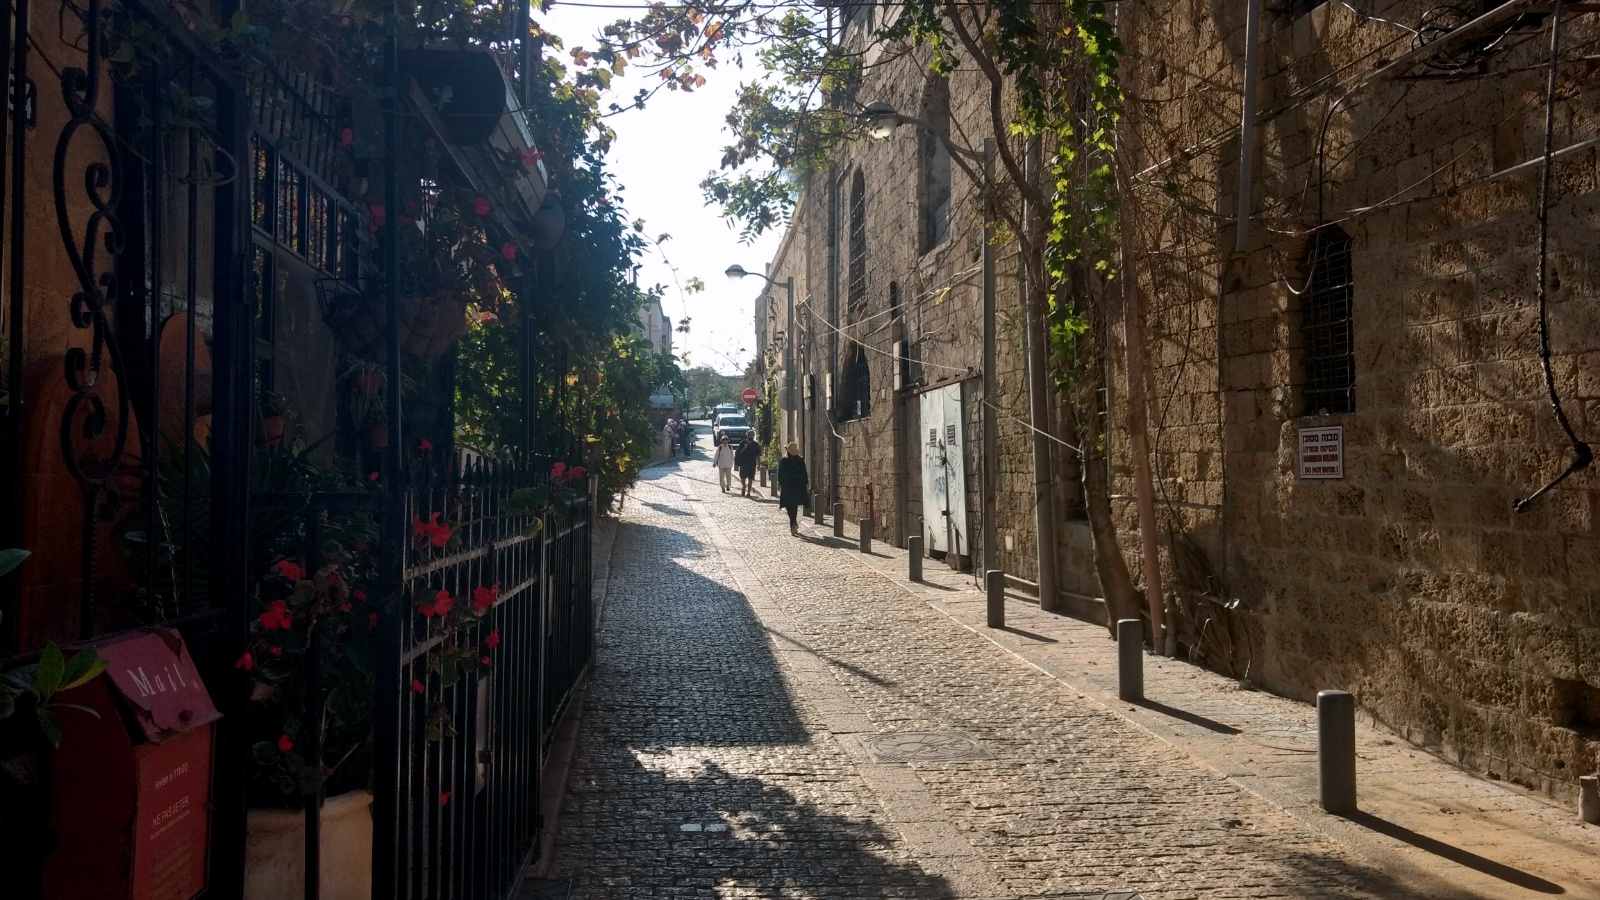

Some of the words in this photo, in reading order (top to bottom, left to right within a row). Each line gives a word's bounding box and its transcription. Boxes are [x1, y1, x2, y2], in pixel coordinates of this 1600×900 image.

[1302, 435, 1319, 445] מסוכן
[1321, 433, 1338, 442] מבנה
[126, 662, 186, 698] Mail
[152, 813, 161, 829] NE
[161, 806, 173, 822] PAS
[172, 795, 190, 815] JETER
